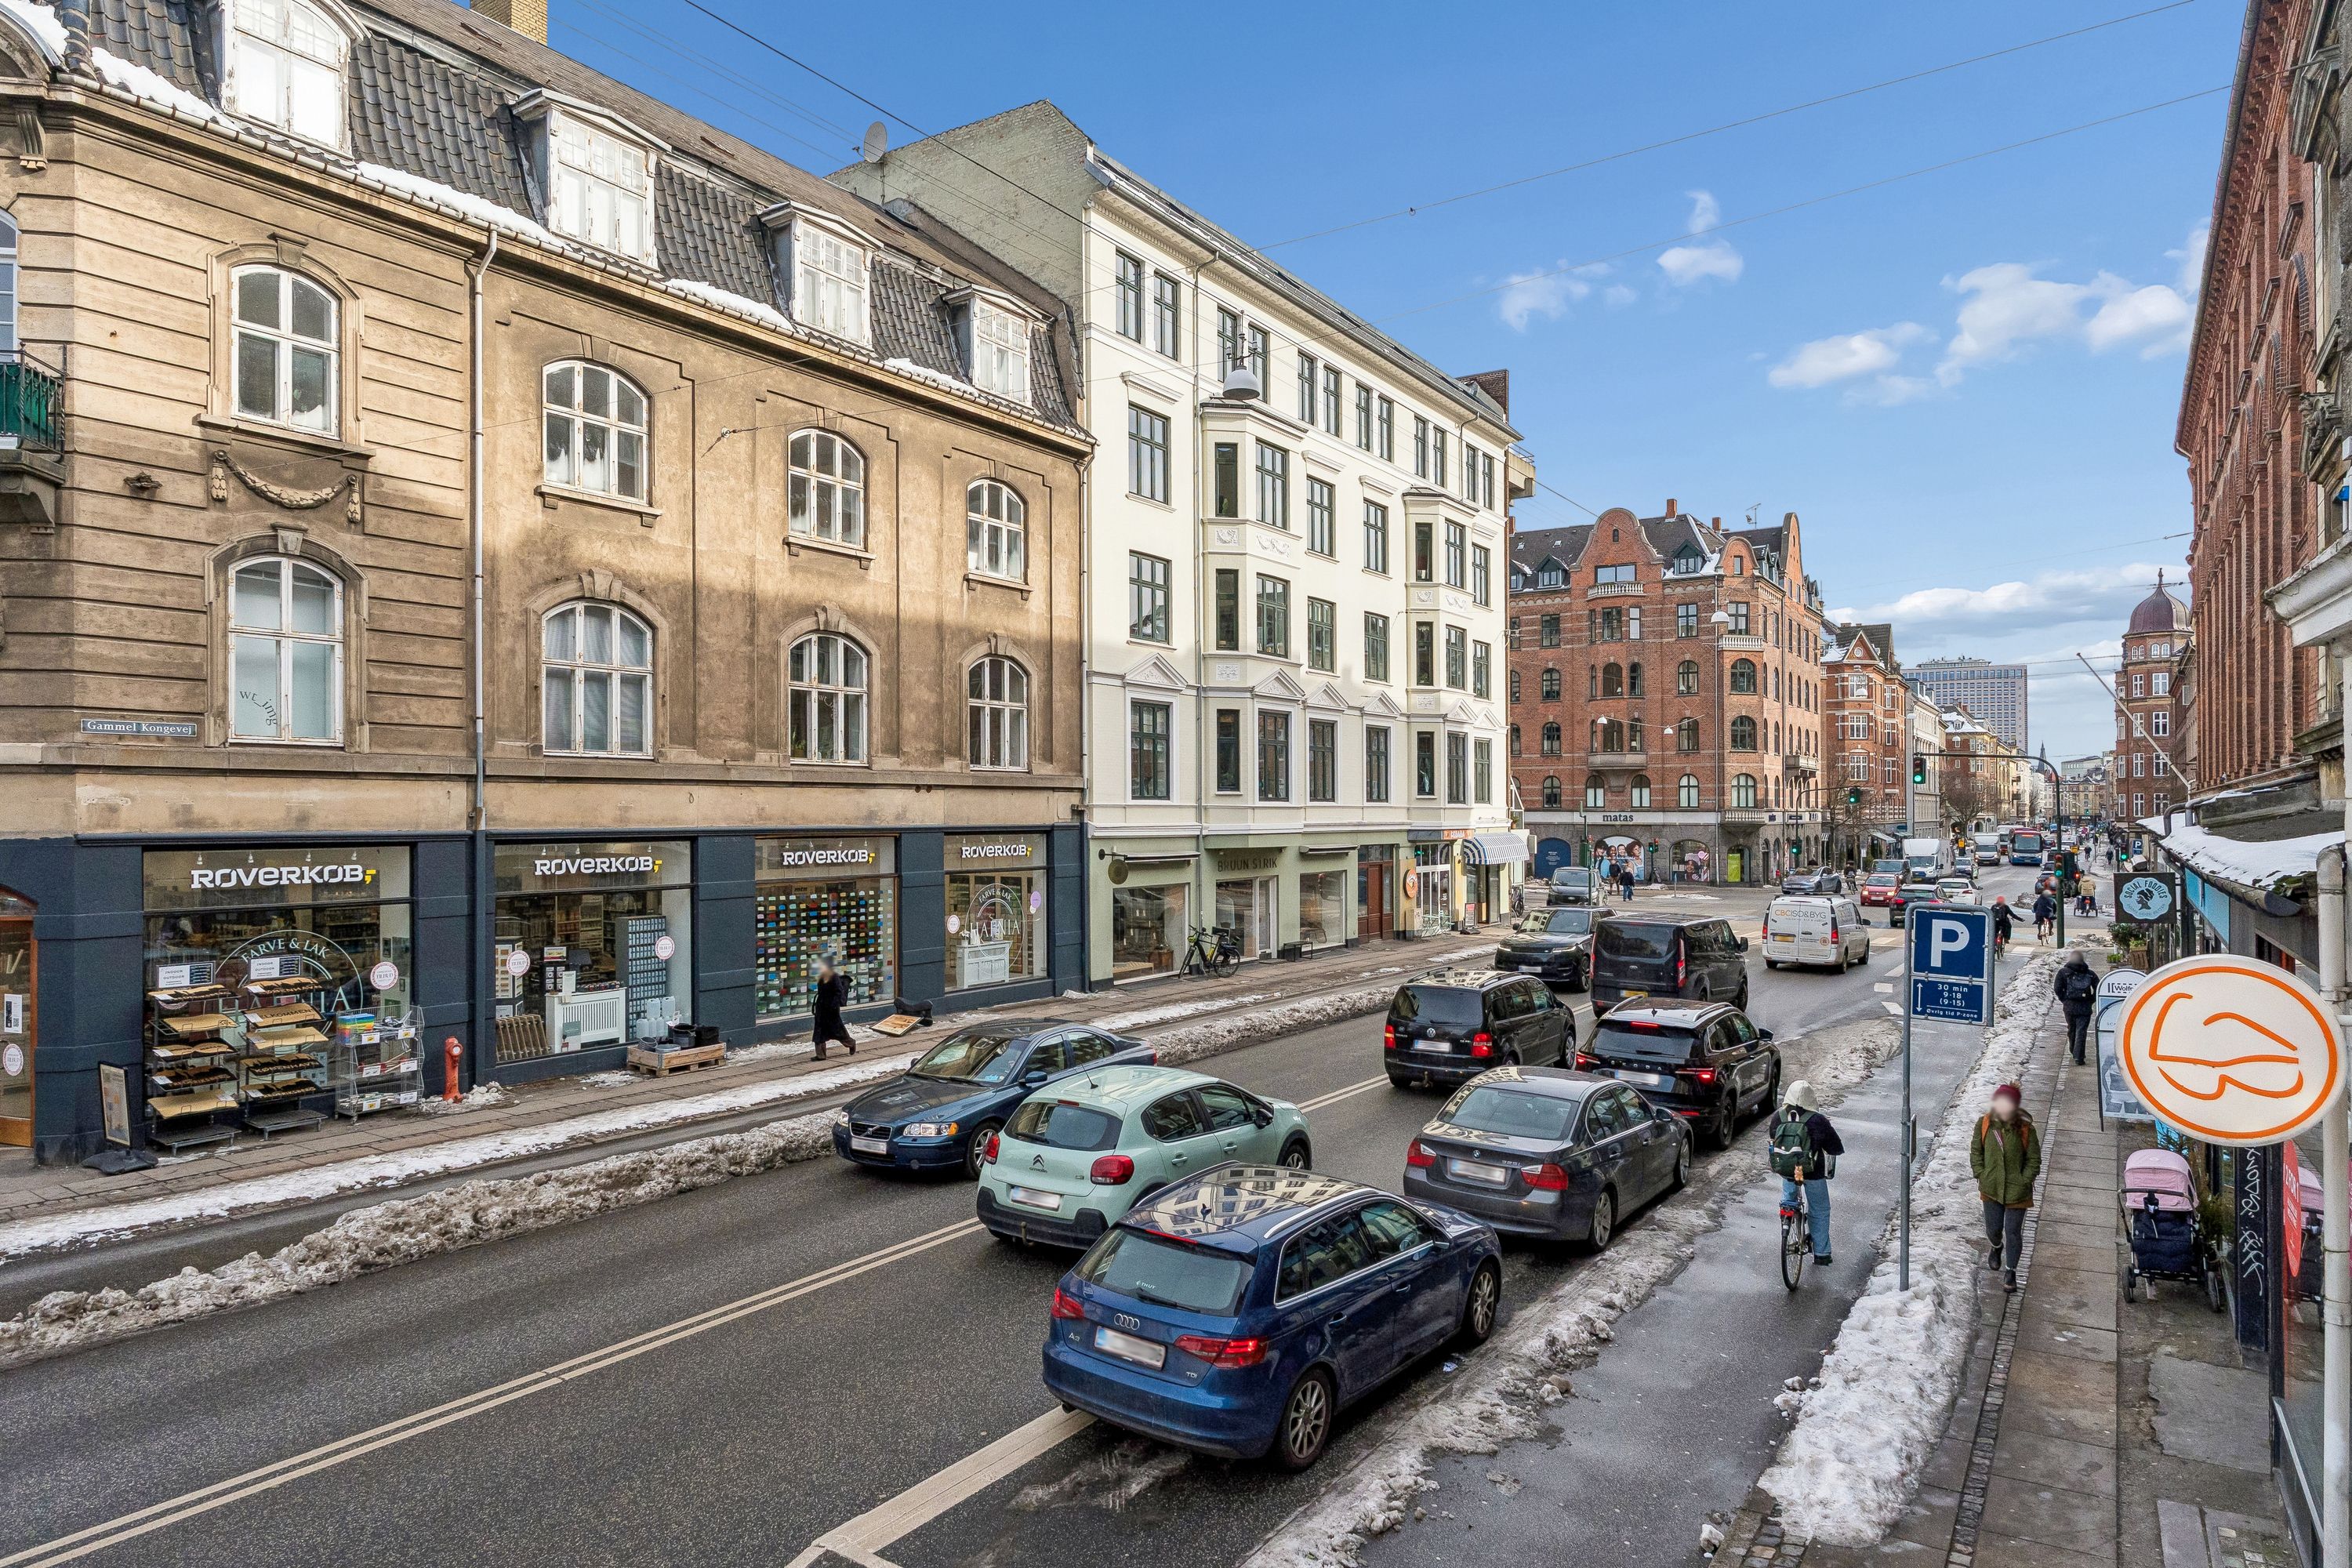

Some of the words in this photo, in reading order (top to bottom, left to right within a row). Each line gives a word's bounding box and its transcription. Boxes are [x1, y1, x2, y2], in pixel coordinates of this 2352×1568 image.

[87, 720, 136, 731] Gammel
[141, 723, 191, 735] Kongevej
[1602, 813, 1634, 822] matas
[1218, 859, 1249, 872] BRUUN
[1252, 858, 1277, 869] STRIK
[978, 888, 996, 903] FARVE
[996, 887, 1002, 896] &
[1002, 890, 1013, 902] LAK
[2124, 881, 2142, 898] SOCIAL
[2144, 880, 2168, 898] FOODIES
[1930, 919, 1970, 967] P
[241, 938, 285, 964] FARVE
[289, 938, 299, 949] &
[303, 940, 330, 959] LAK
[1952, 983, 1968, 993] min
[1940, 997, 1965, 1007] (9-15)
[1069, 1332, 1080, 1341] A3
